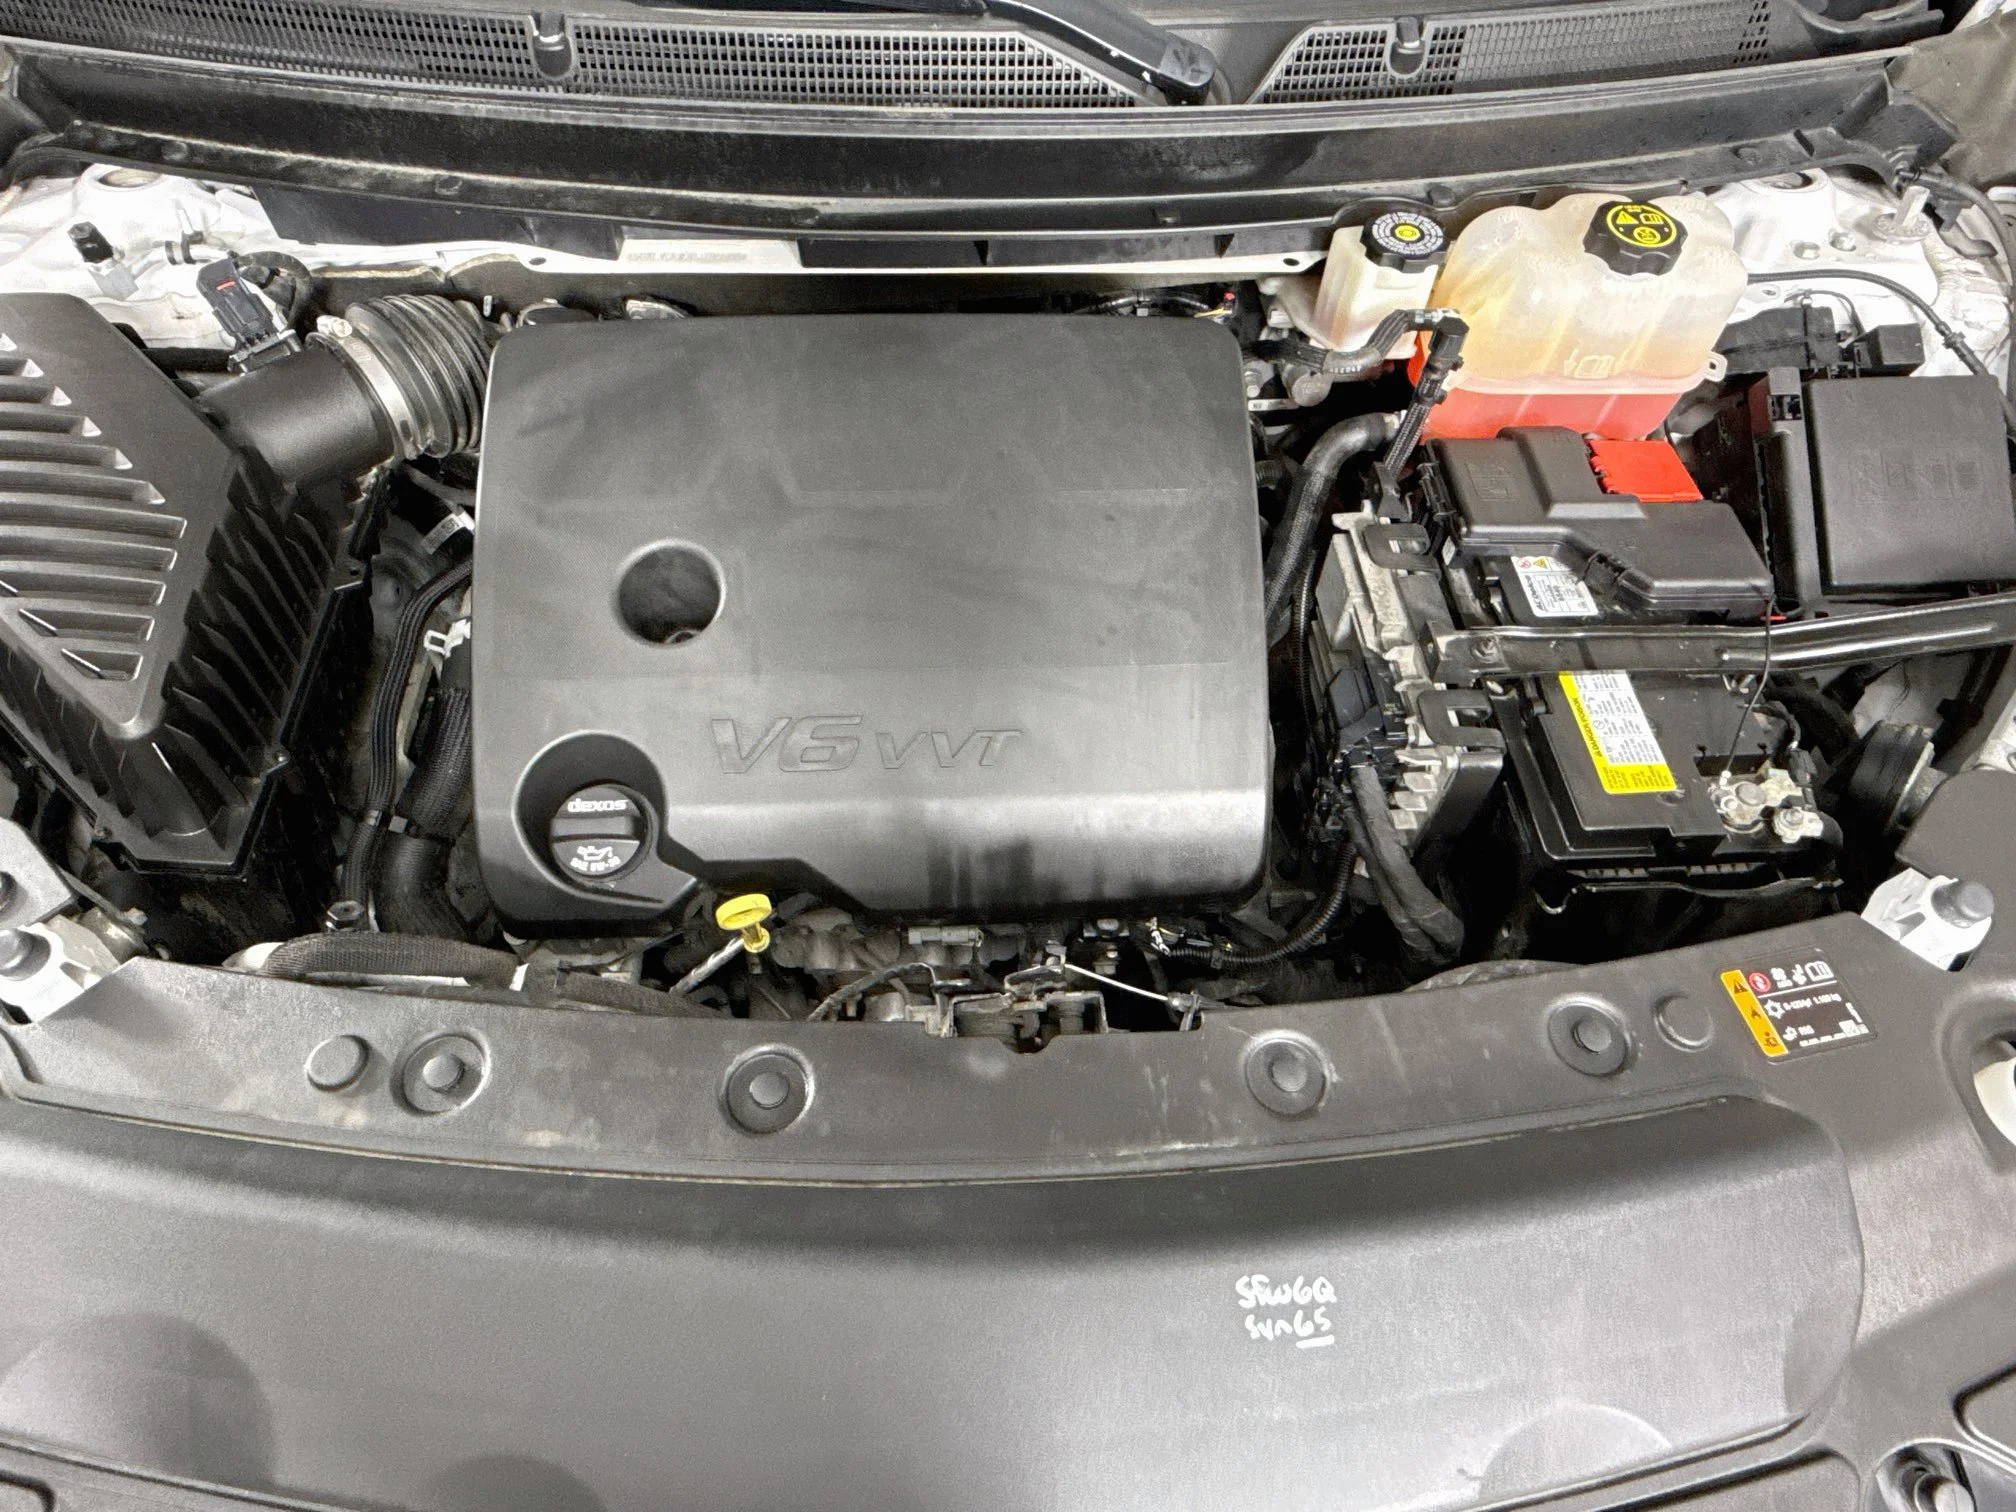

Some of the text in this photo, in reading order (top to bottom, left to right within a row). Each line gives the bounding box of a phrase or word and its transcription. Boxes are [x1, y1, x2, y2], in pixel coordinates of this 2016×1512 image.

[711, 714, 1024, 774] V6 VVT
[567, 797, 628, 812] dexos
